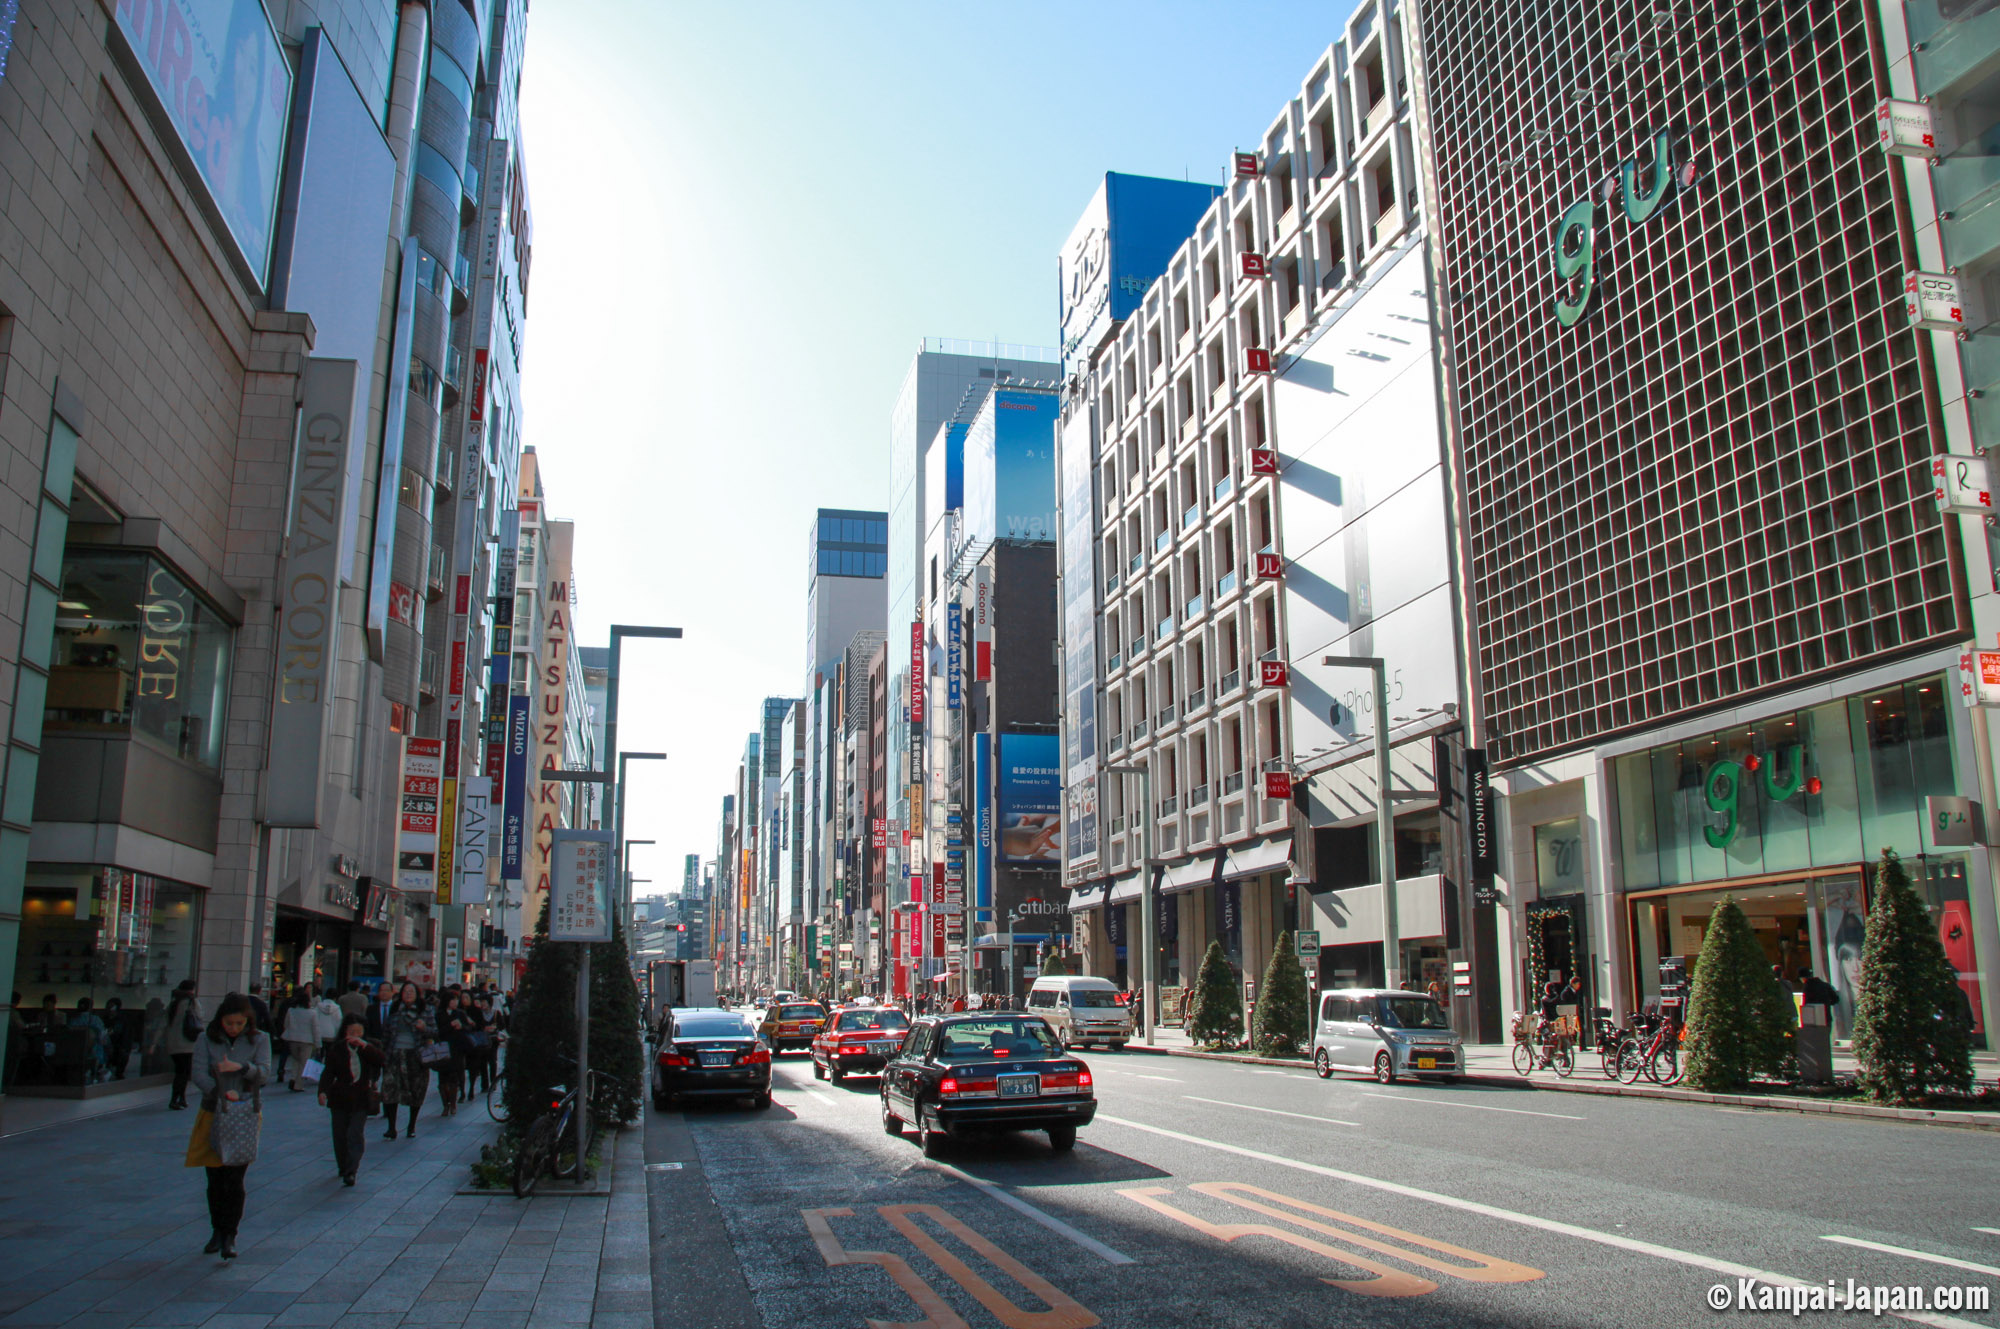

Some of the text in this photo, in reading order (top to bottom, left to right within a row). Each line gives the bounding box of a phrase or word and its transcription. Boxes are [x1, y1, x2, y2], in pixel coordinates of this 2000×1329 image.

[1894, 115, 1929, 128] MUSÉE
[999, 400, 1037, 412] docomo
[281, 412, 344, 704] GINZA CORE
[978, 582, 989, 625] docomo
[137, 567, 189, 700] CORE
[912, 665, 922, 715] NATARAJ
[1343, 668, 1403, 722] iPhoe 5
[514, 709, 526, 755] MIZUHO
[536, 580, 567, 893] MATSUZAKAYA
[409, 816, 433, 825] ECC
[463, 794, 487, 885] FANCL
[979, 805, 991, 847] citibank
[1473, 771, 1488, 858] WASHINGTON
[506, 815, 520, 865] みずほ銀行
[566, 893, 574, 932] になります
[575, 847, 586, 928] 車両通行禁止
[934, 882, 944, 938] DALYAU
[1018, 899, 1070, 915] citiban
[1114, 1181, 1546, 1297] 50
